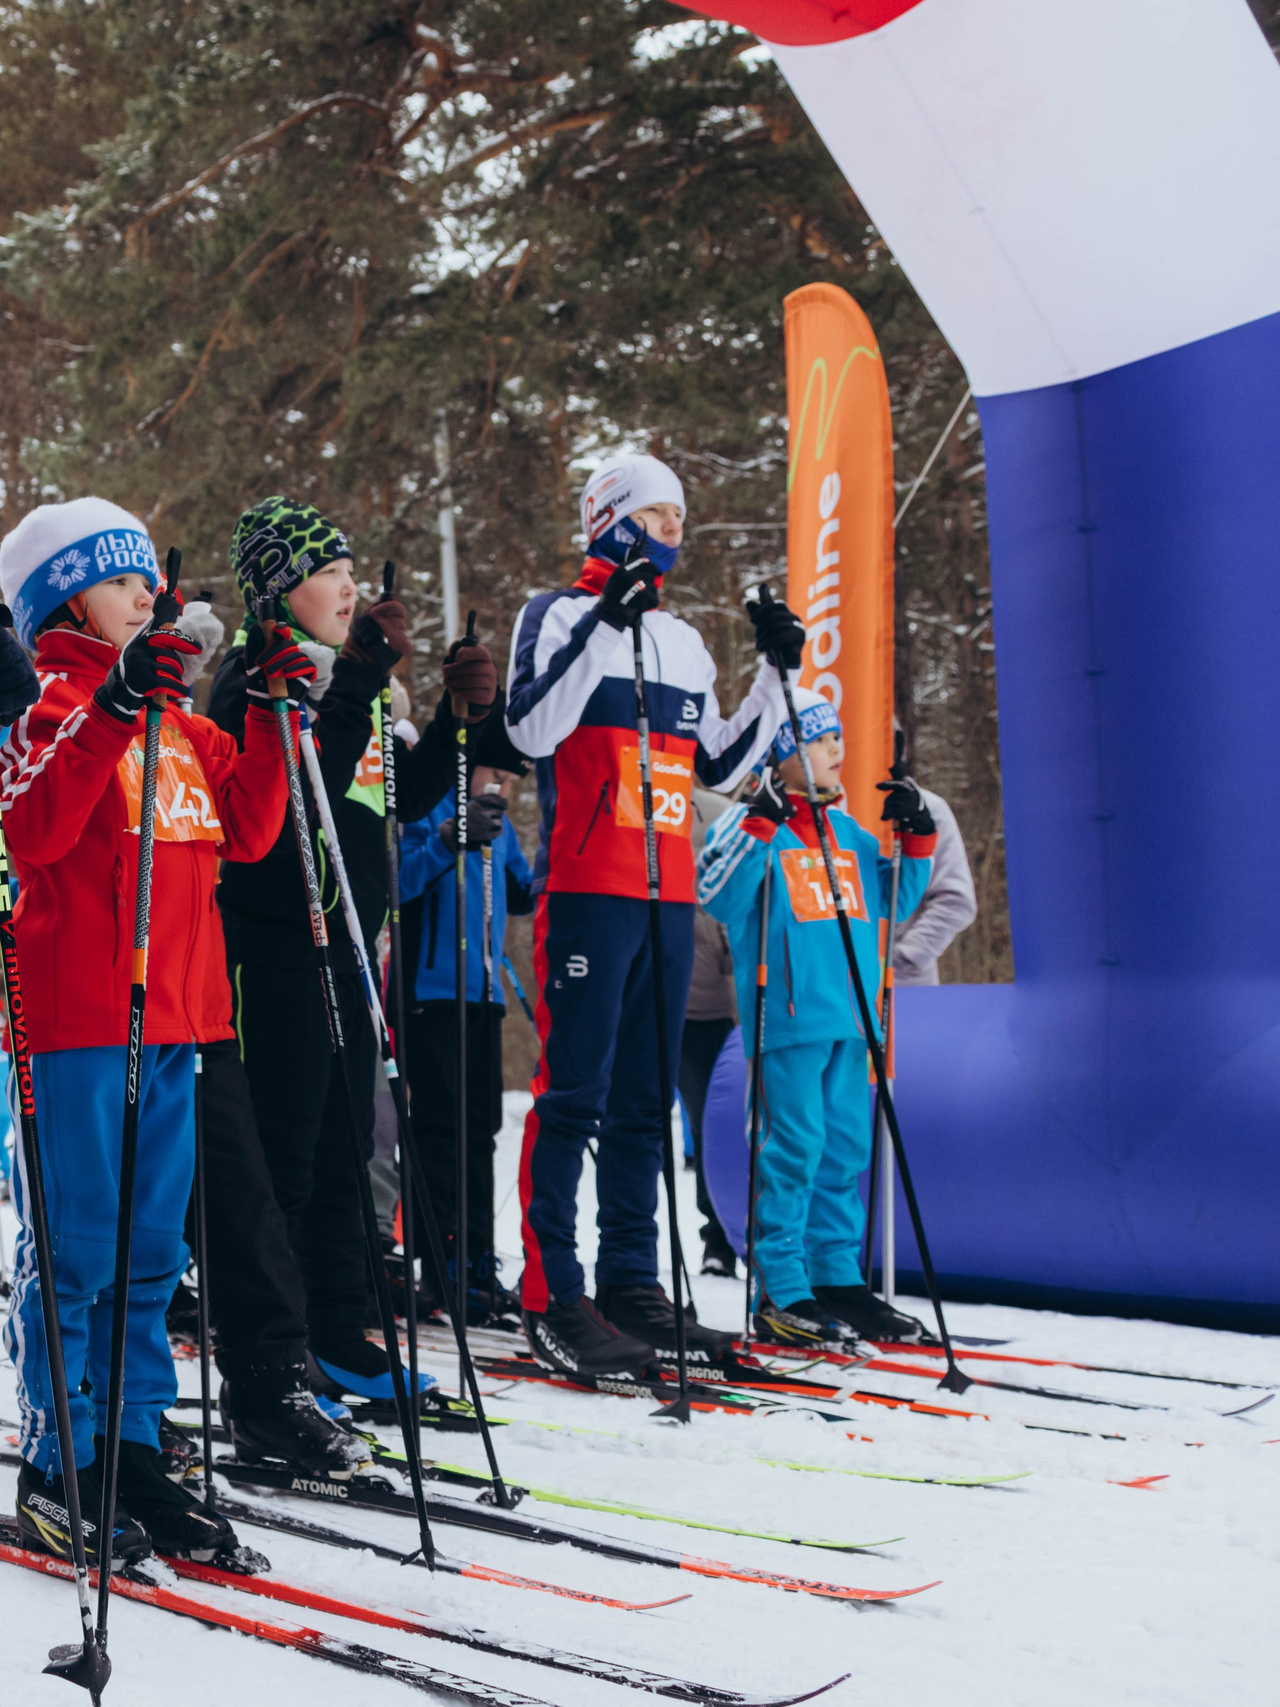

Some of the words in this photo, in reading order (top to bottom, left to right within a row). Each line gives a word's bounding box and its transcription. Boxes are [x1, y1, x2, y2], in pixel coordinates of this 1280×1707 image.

[382, 713, 396, 808] NORDWAY
[153, 782, 221, 828] 142
[457, 753, 468, 843] NORDWAY
[596, 1379, 656, 1400] ROSSIGNOL
[291, 1478, 348, 1498] ATOMIC
[27, 1493, 96, 1538] FISCHR
